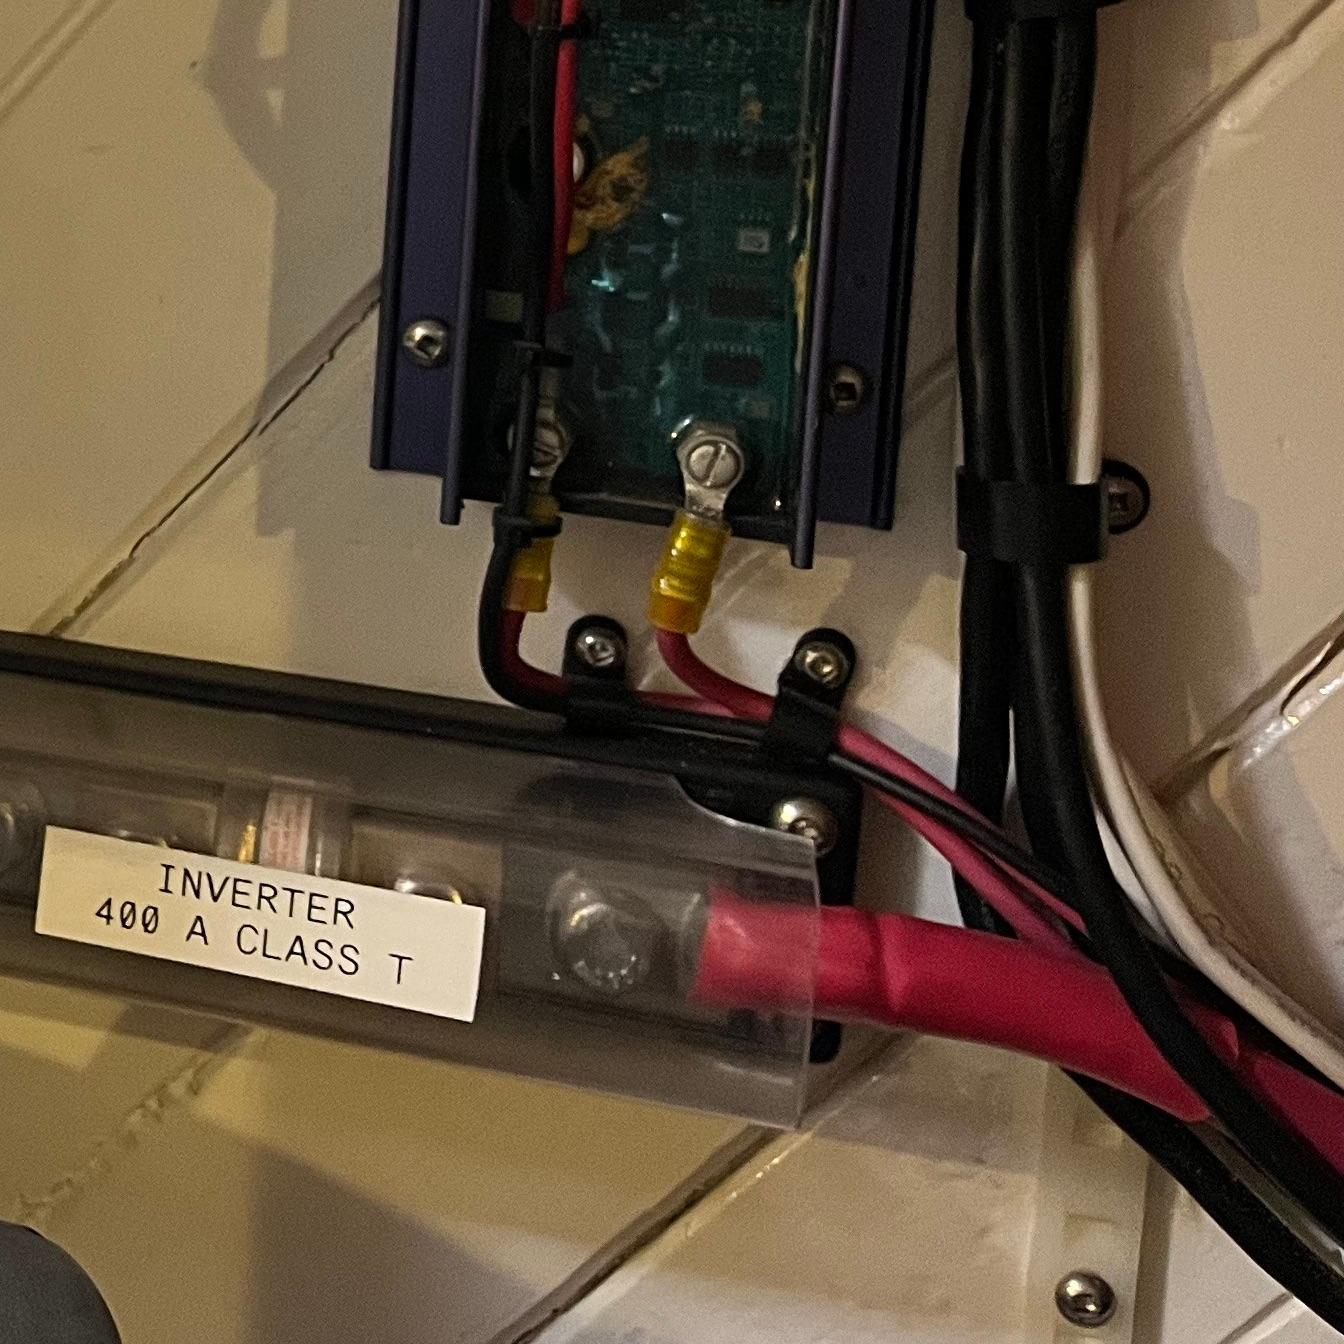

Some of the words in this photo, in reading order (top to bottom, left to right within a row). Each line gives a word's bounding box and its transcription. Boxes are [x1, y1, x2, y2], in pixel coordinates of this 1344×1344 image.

[158, 862, 357, 929] INVERTER
[95, 896, 160, 935] 400
[185, 915, 210, 947] A
[236, 924, 361, 977] CLASS
[388, 952, 414, 985] T
